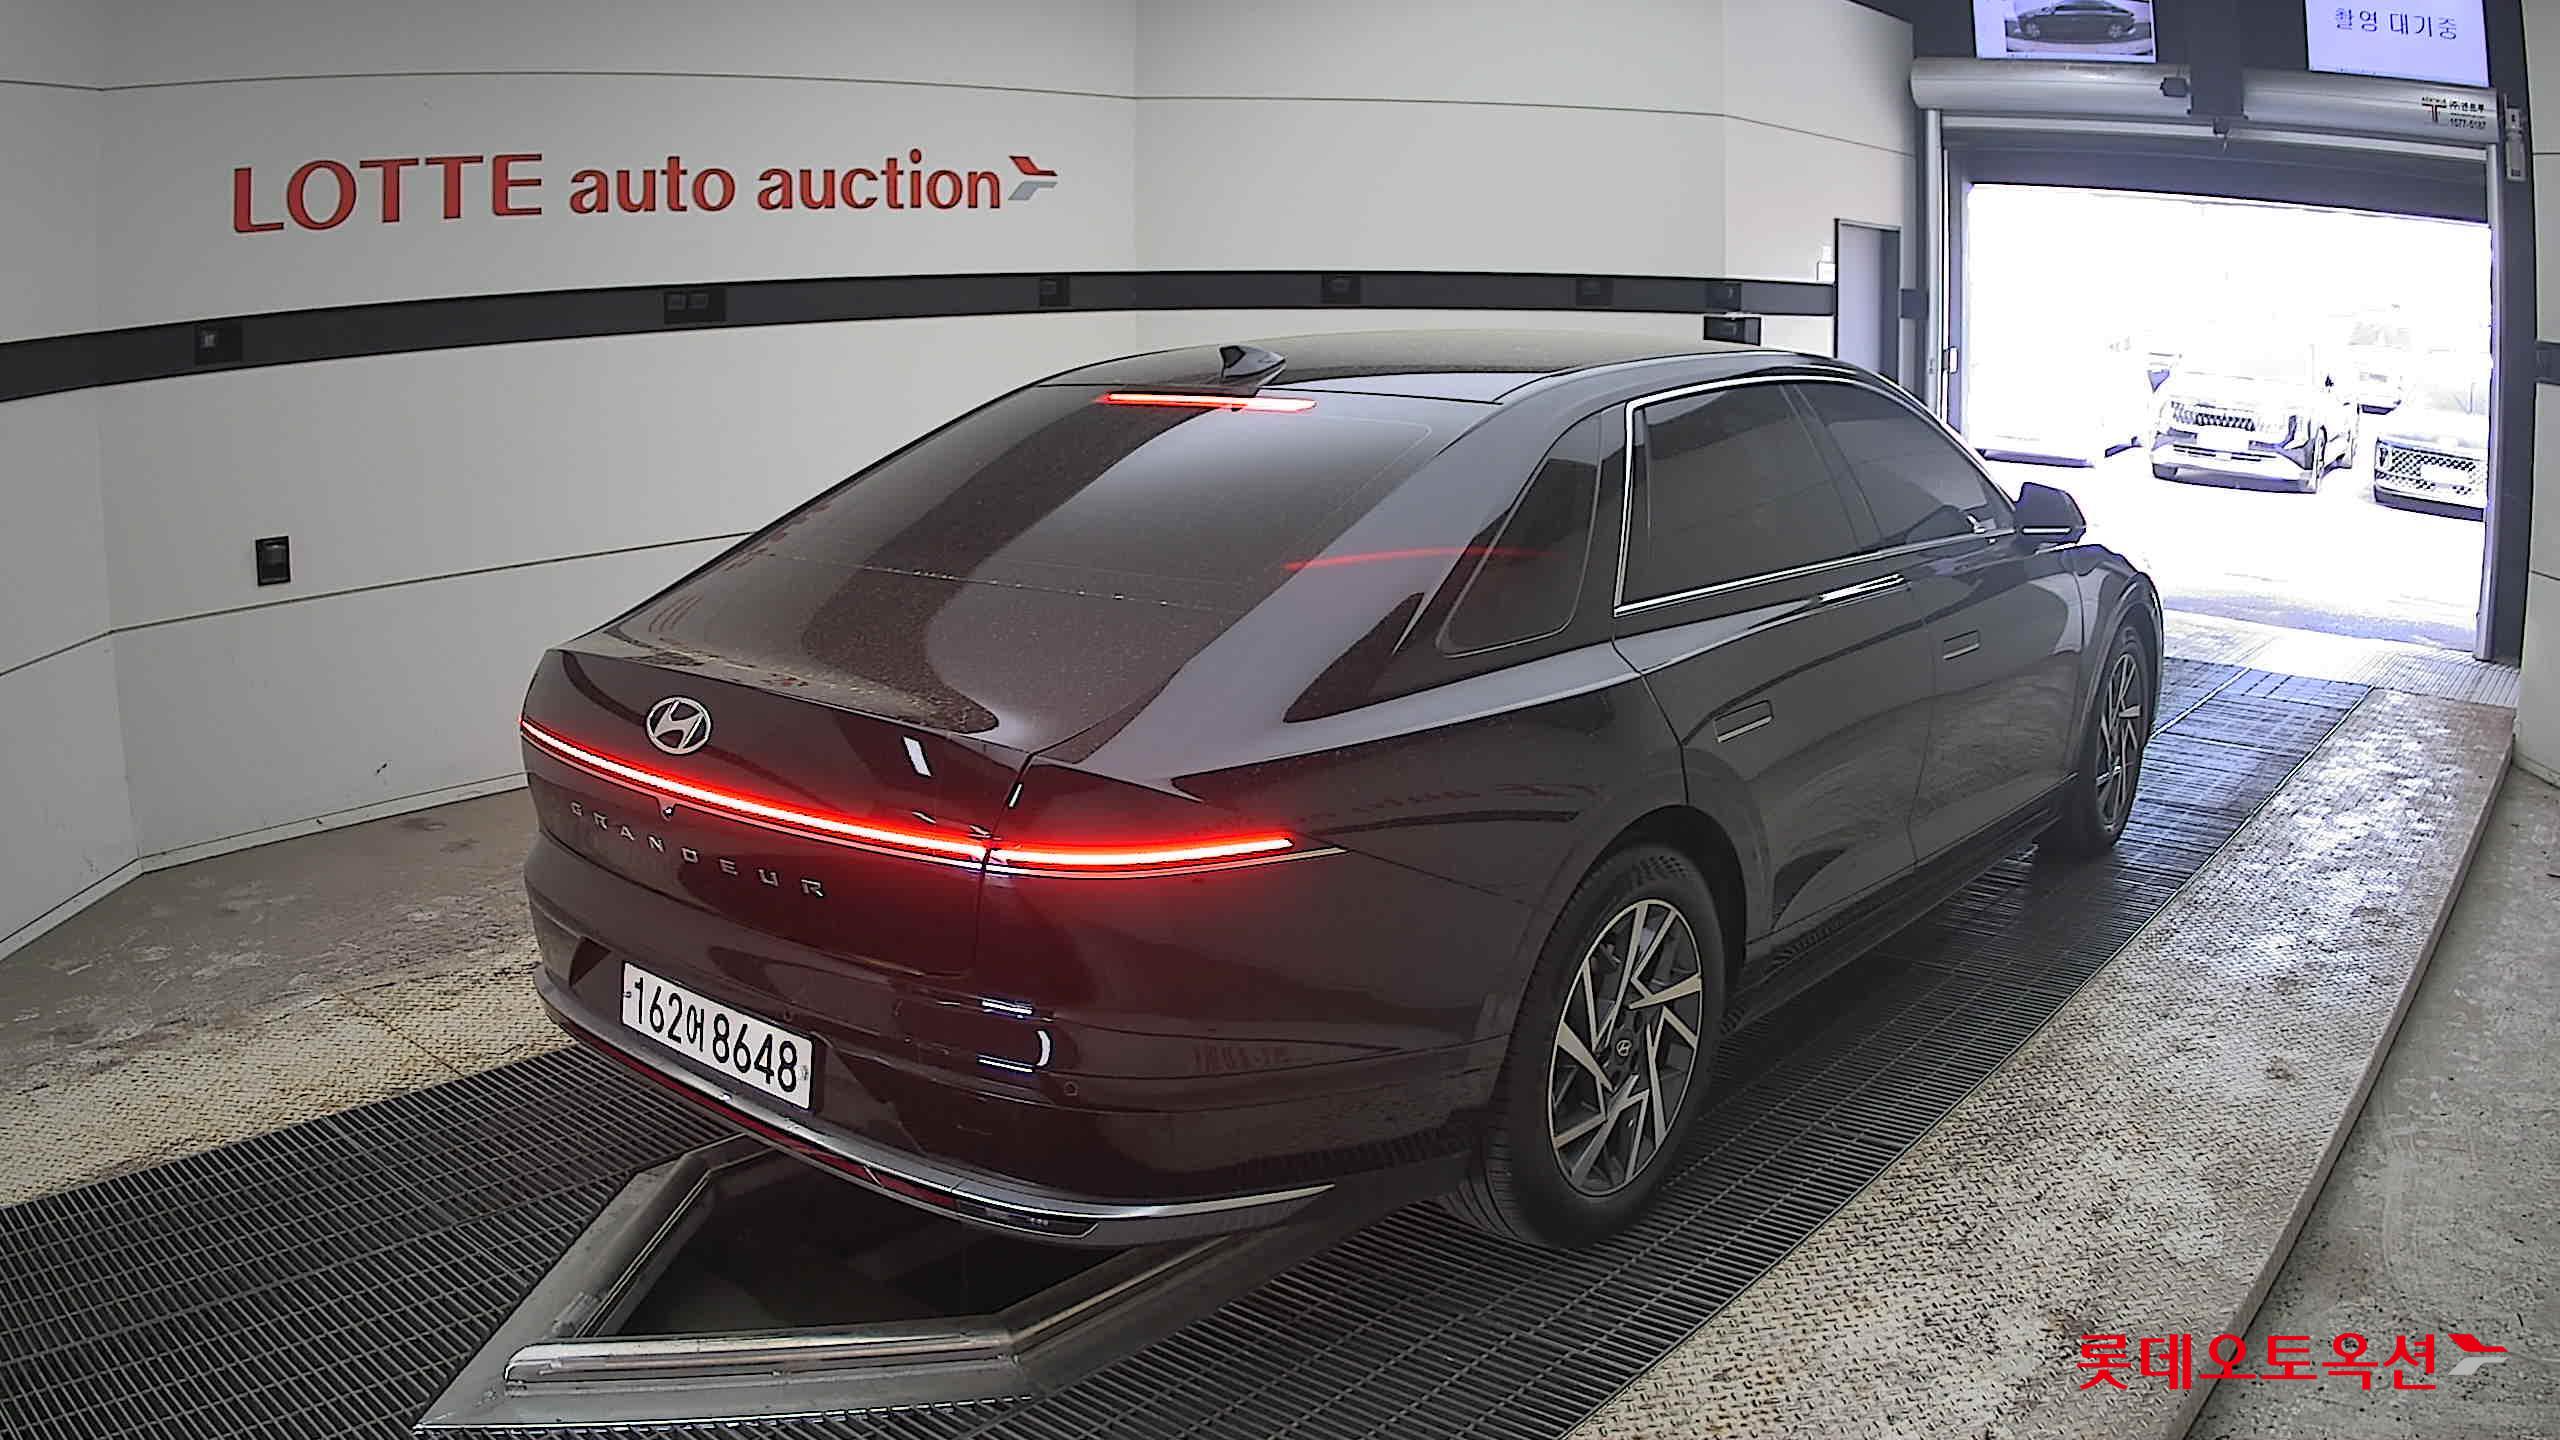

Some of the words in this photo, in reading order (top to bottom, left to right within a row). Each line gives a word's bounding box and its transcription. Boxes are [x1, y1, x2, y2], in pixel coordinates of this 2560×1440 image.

[2389, 12, 2458, 41] 대기중
[233, 153, 543, 233] LOTTE
[569, 156, 737, 213] auto
[757, 147, 1002, 210] auction
[570, 801, 824, 897] GRANDEUR
[634, 976, 705, 1053] 162어
[712, 1012, 798, 1093] 8648
